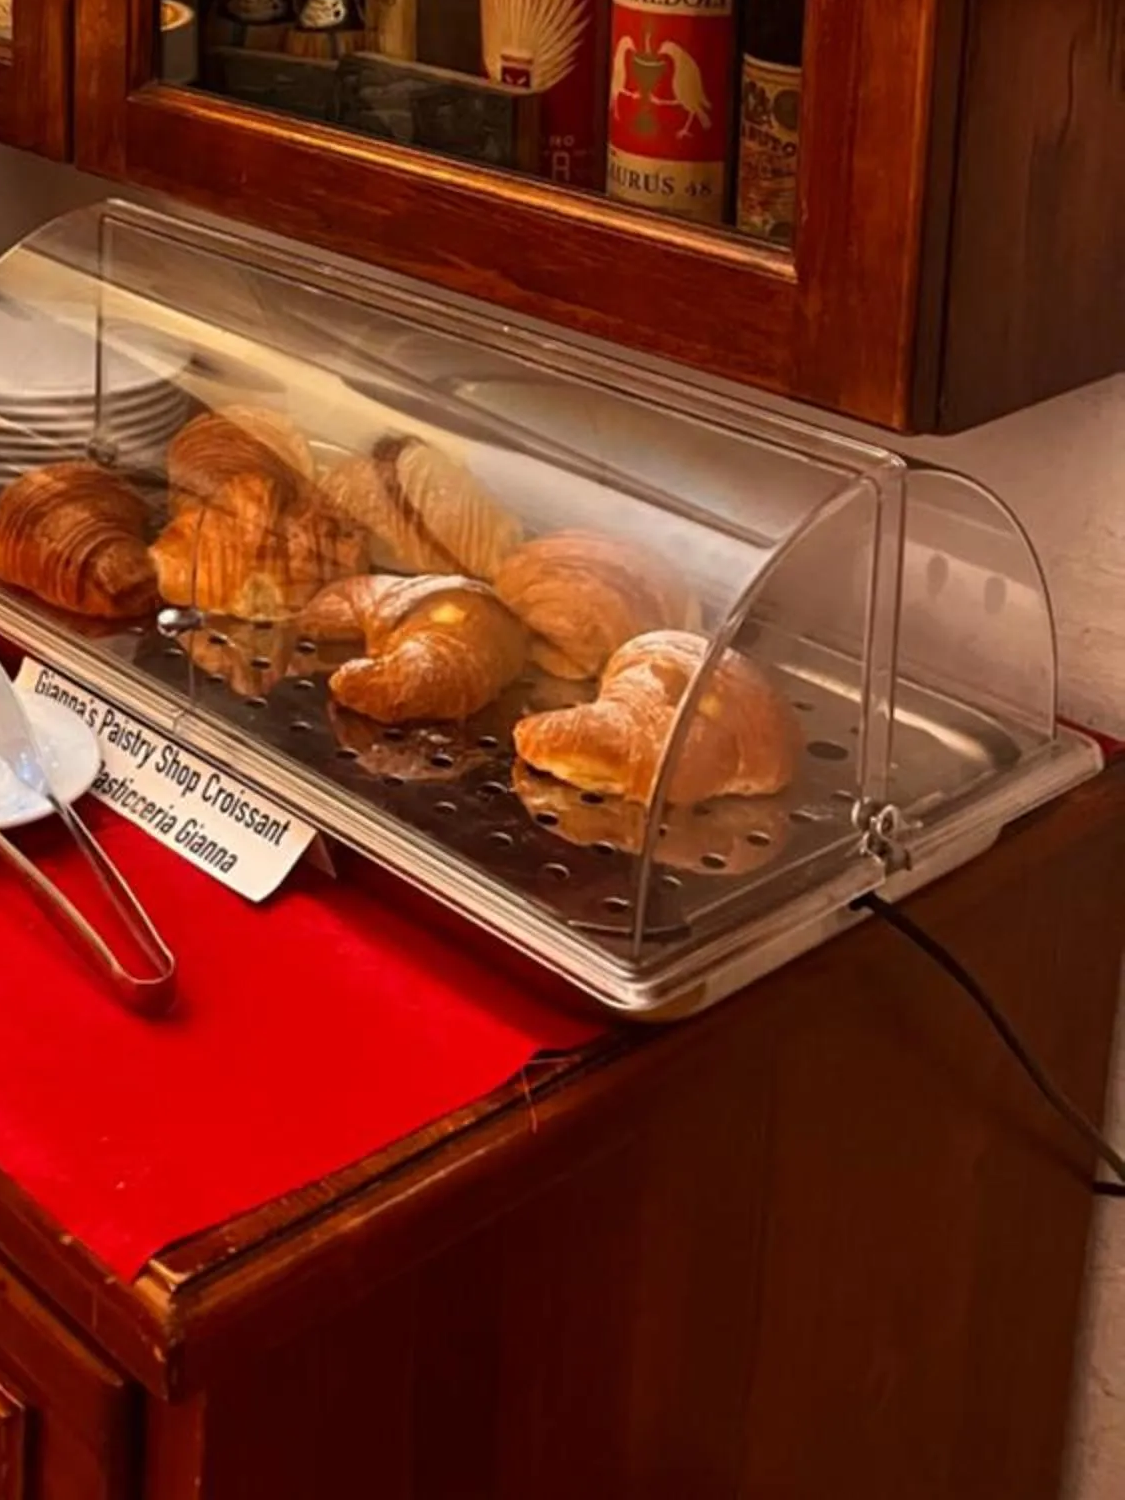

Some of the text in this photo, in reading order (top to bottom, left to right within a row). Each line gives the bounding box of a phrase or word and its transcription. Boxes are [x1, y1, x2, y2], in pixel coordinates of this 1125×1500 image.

[34, 668, 291, 847] Gianna's Paistry Shop Croissant
[174, 818, 239, 874] Gianna
